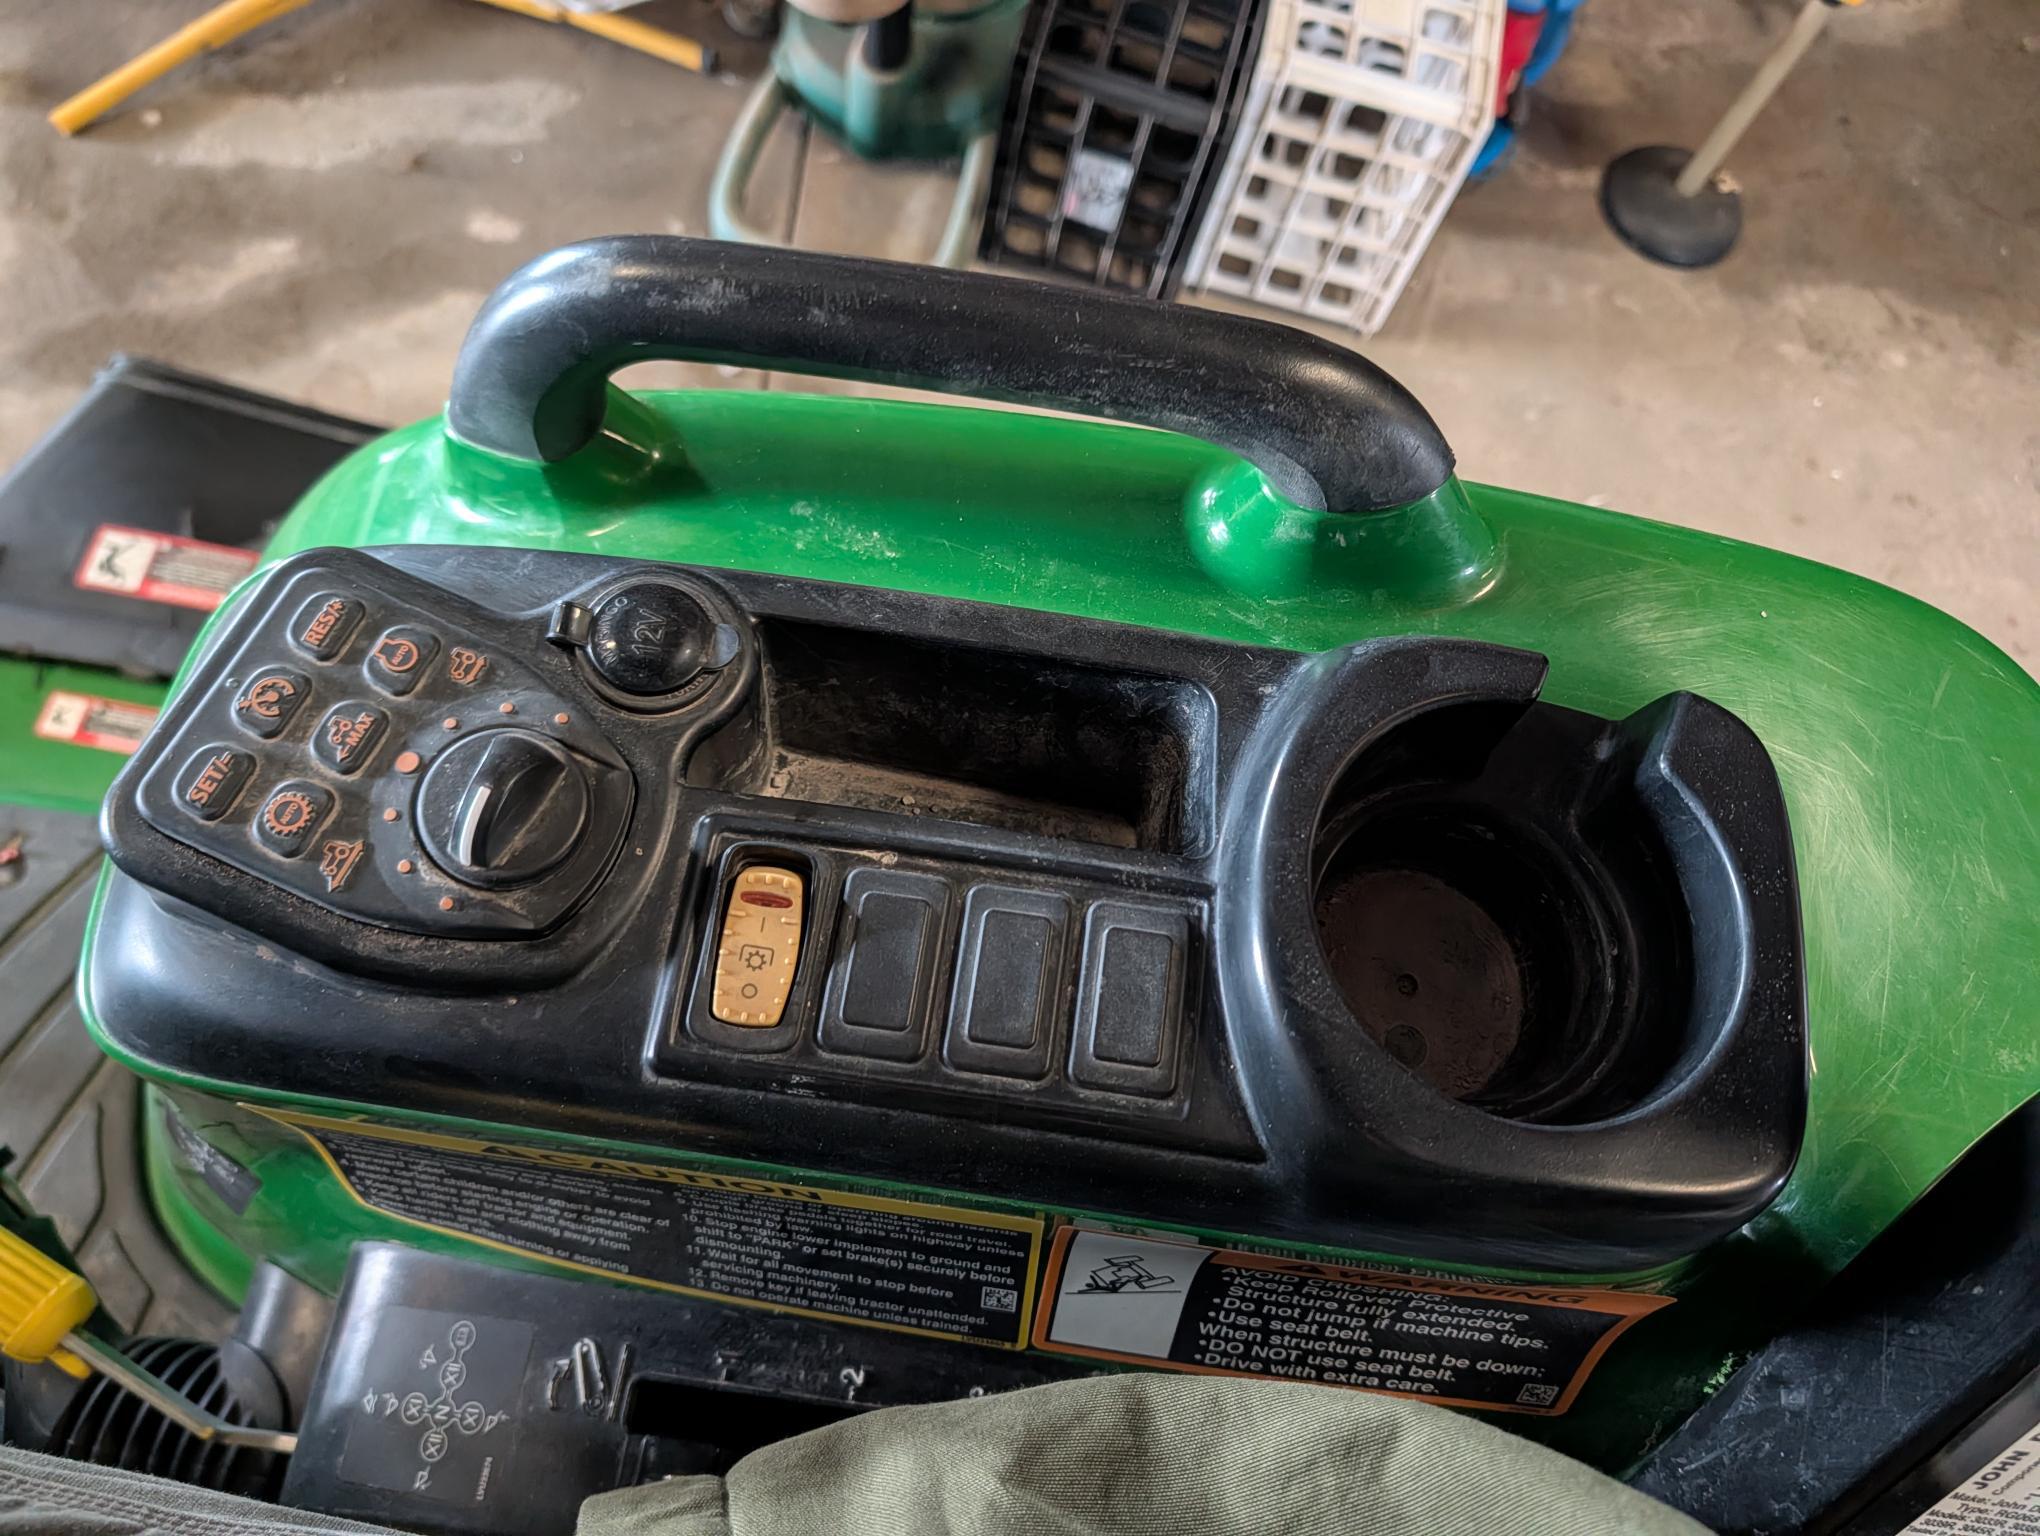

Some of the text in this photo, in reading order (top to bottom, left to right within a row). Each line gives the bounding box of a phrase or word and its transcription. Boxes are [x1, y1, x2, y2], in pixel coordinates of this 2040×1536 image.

[302, 598, 345, 647] RES/+
[632, 607, 667, 655] 12V
[391, 644, 409, 667] AUTO
[347, 711, 376, 749] MAX
[280, 803, 299, 824] AUTO
[538, 1153, 824, 1201] CAUTION
[443, 1177, 499, 1194] children
[501, 1187, 545, 1203] and/or
[548, 1196, 592, 1213] others
[594, 1205, 618, 1218] are
[619, 1209, 654, 1226] clear
[656, 1217, 671, 1229] of
[461, 1189, 513, 1206] starting
[515, 1199, 561, 1216] engine
[563, 1209, 580, 1220] or
[581, 1213, 650, 1234] operation.
[483, 1202, 528, 1217] tractor
[530, 1211, 556, 1224] and
[558, 1218, 632, 1241] equipment.
[691, 1207, 815, 1234] prohibited by law.
[480, 1209, 506, 1223] and
[508, 1215, 561, 1238] clothing
[563, 1228, 598, 1246] away
[599, 1234, 632, 1252] from
[682, 1213, 1012, 1276] 10. Stop engine lower implement to ground and
[692, 1200, 720, 1211] Use
[723, 1205, 781, 1222] flashing
[785, 1214, 842, 1232] warning
[846, 1224, 887, 1239] lights
[890, 1232, 909, 1241] on
[912, 1234, 973, 1251] highway
[977, 1243, 1026, 1259] unless
[695, 1235, 786, 1261] dismounting.
[841, 1215, 901, 1232] together
[906, 1224, 926, 1236] for
[930, 1230, 963, 1242] road
[967, 1235, 1012, 1248] travel.
[508, 1235, 554, 1256] turning
[573, 1254, 630, 1274] applying
[694, 1226, 1017, 1287] shift to "PARK" or set brake(s) securely before
[702, 1258, 842, 1293] servicing machinery.
[688, 1267, 991, 1326] 12. Remove key if leaving tractor unattended.
[741, 1253, 761, 1266] for
[763, 1256, 781, 1270] all
[782, 1261, 854, 1283] movement
[857, 1274, 873, 1286] to
[874, 1277, 908, 1293] stop
[909, 1281, 955, 1300] before
[1222, 1266, 1451, 1303] AVOID CRUSHING:
[1340, 1270, 1588, 1305] WARNING
[711, 1280, 731, 1294] Do
[733, 1285, 757, 1298] not
[759, 1290, 809, 1308] operate
[812, 1297, 870, 1318] machine
[872, 1310, 918, 1326] unless
[920, 1318, 974, 1335] trained.
[1228, 1285, 1517, 1332] Structure fully extended.
[1233, 1276, 1530, 1322] Keep Rollover Protective
[1219, 1310, 1374, 1342] Use seat belt.
[1223, 1297, 1550, 1350] Do not jump if machine tips.
[1199, 1322, 1547, 1378] When structure must be down:
[1208, 1338, 1457, 1382] DO NOT use seat belt.
[1204, 1352, 1440, 1394] Drive with extra care.
[432, 1405, 450, 1421] N
[1972, 1450, 2031, 1491] JOHN
[1950, 1491, 1992, 1505] Make:
[1991, 1499, 2028, 1511] John
[1956, 1503, 1994, 1516] Type:
